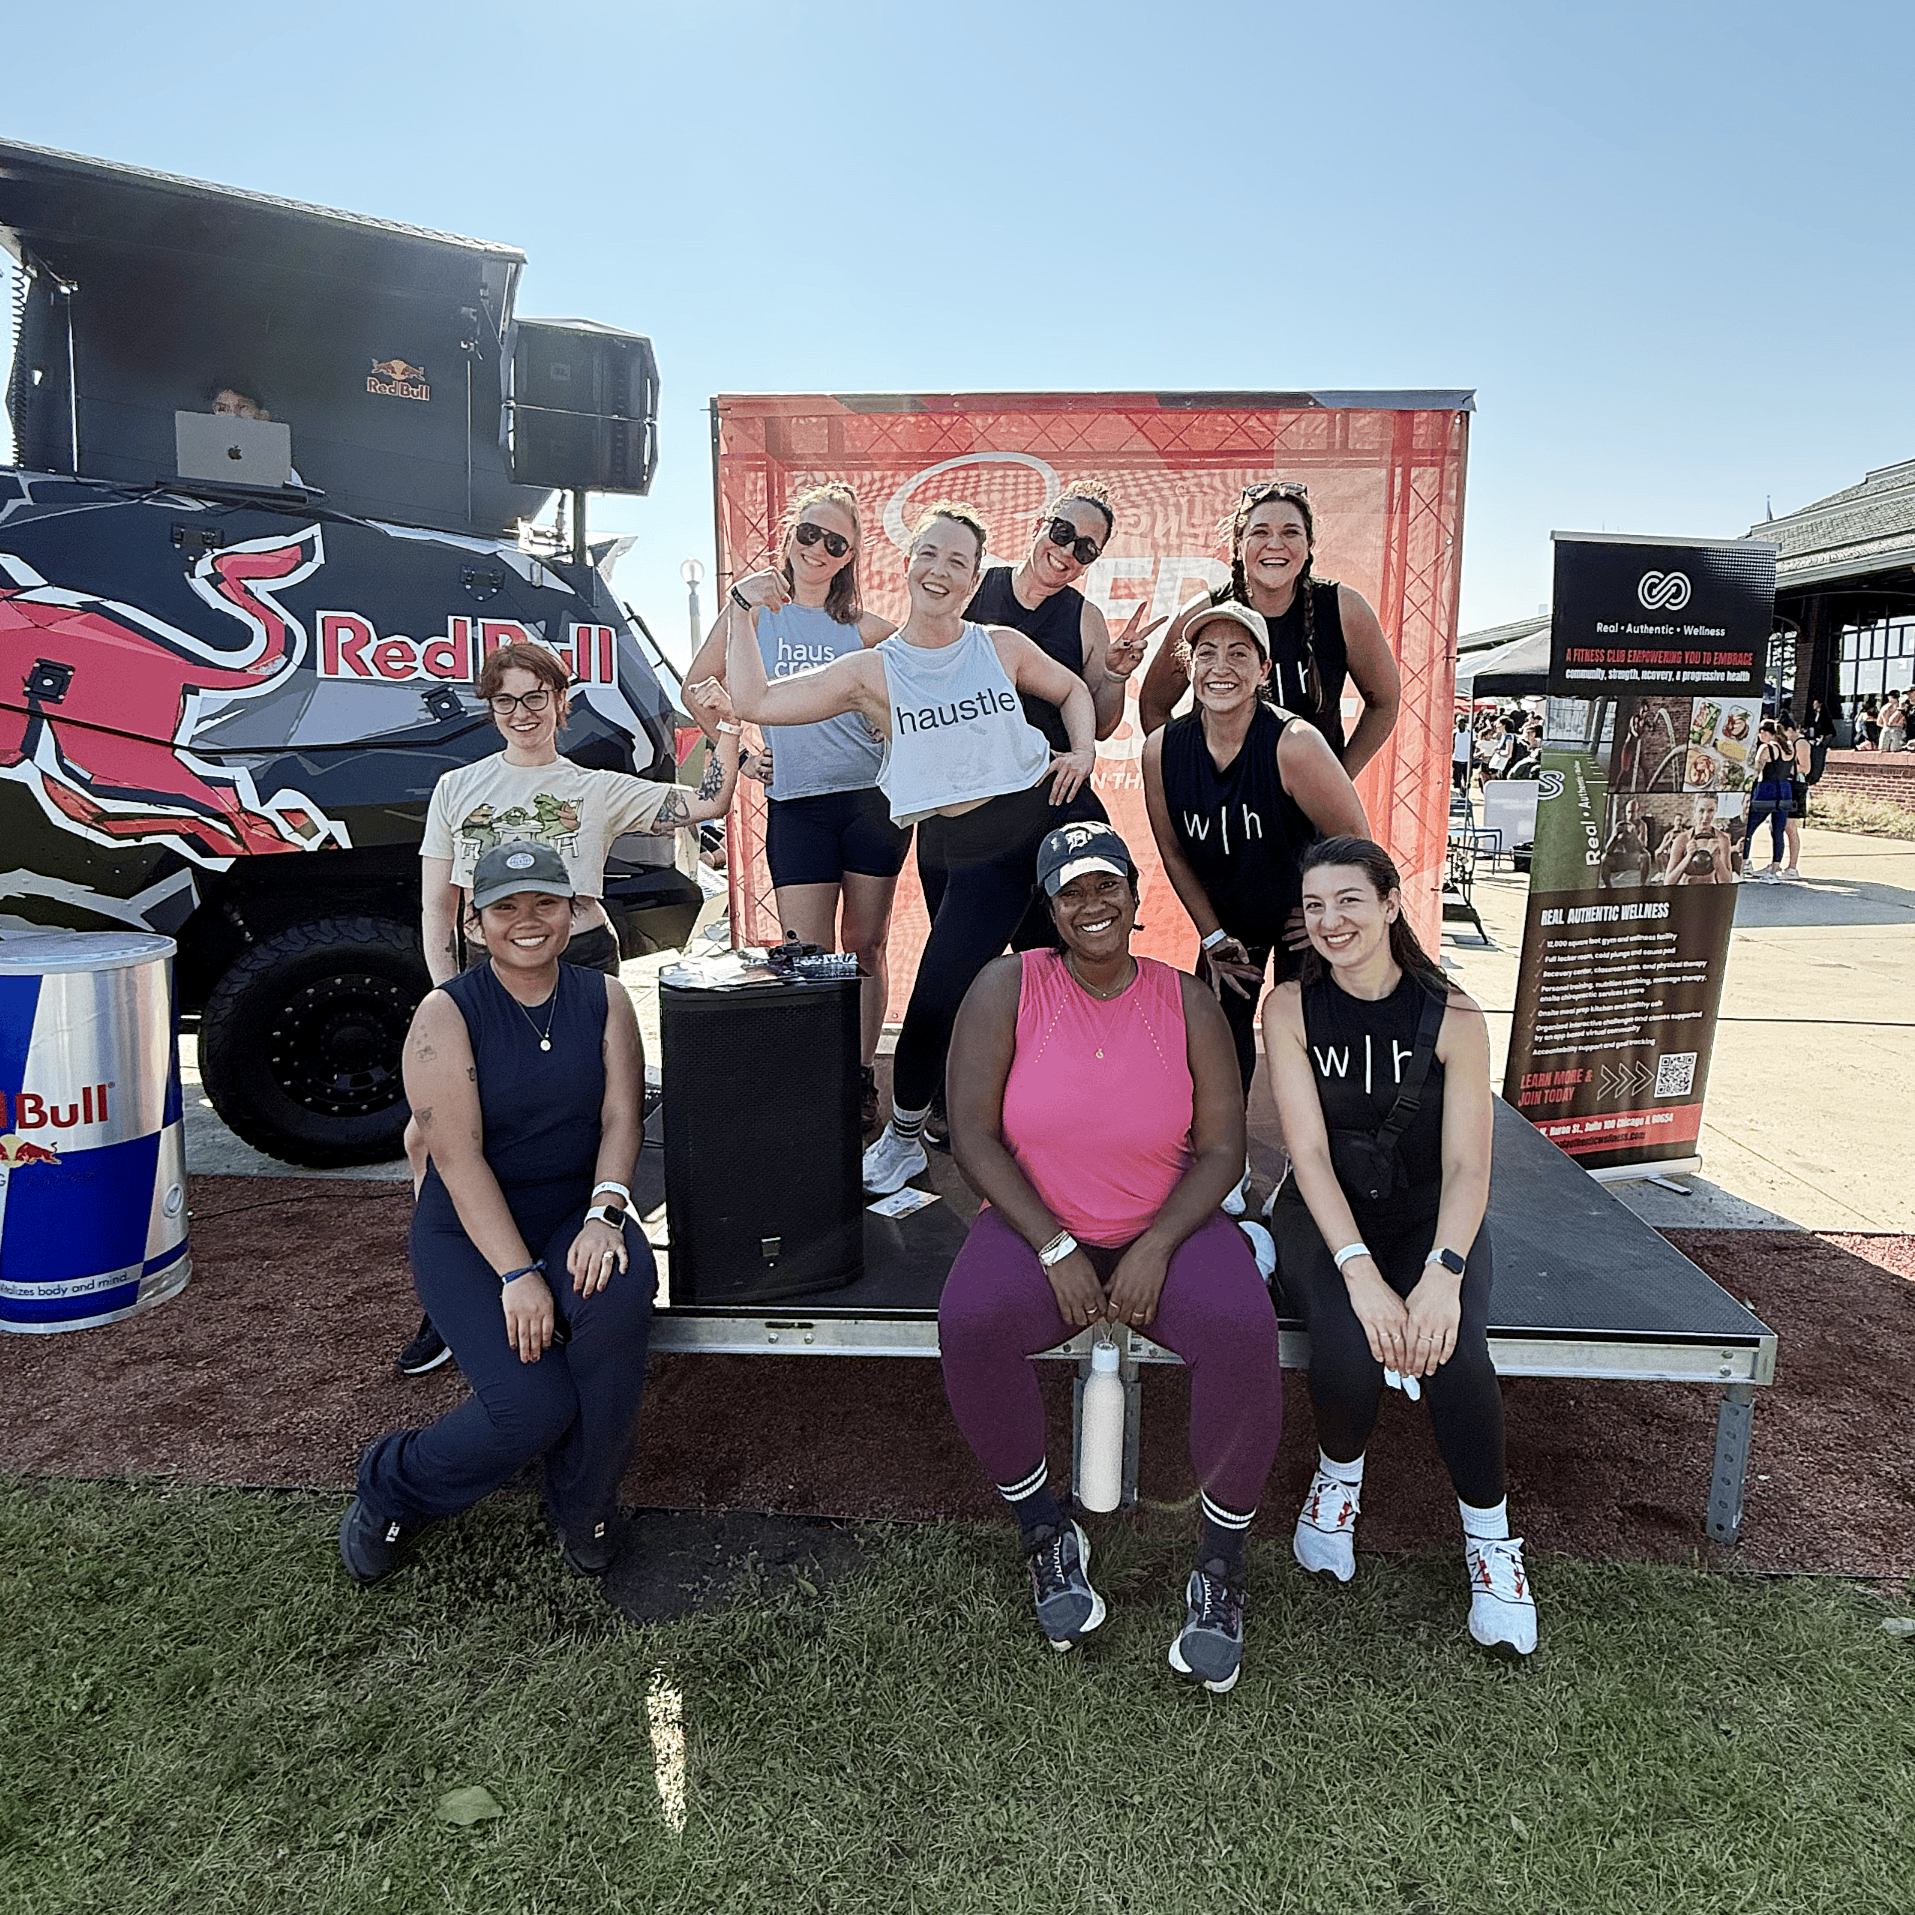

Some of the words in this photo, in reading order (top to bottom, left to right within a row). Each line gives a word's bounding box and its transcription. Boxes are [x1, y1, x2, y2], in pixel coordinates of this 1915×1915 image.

[367, 377, 398, 395] Red
[399, 381, 430, 401] Bull
[1596, 622, 1619, 633] Real
[1625, 623, 1675, 635] Authentic
[1683, 624, 1726, 637] Wellness
[320, 614, 470, 681] Red
[778, 637, 836, 661] haus
[1573, 648, 1605, 663] FITNESS
[1713, 651, 1754, 666] EMBRACE
[1681, 669, 1725, 683] progressive
[896, 687, 1016, 735] haustle
[1580, 821, 1600, 866] Real
[1540, 908, 1565, 926] REAL
[1566, 905, 1620, 925] AUTHENTIC
[1620, 902, 1670, 921] WELLNESS
[1520, 1072, 1552, 1090] LEARN
[1553, 1068, 1584, 1085] MORE
[16, 1083, 108, 1129] Bull
[1518, 1089, 1541, 1107] JOIN
[1544, 1086, 1576, 1103] TODAY
[38, 1283, 68, 1297] body
[72, 1278, 95, 1293] and
